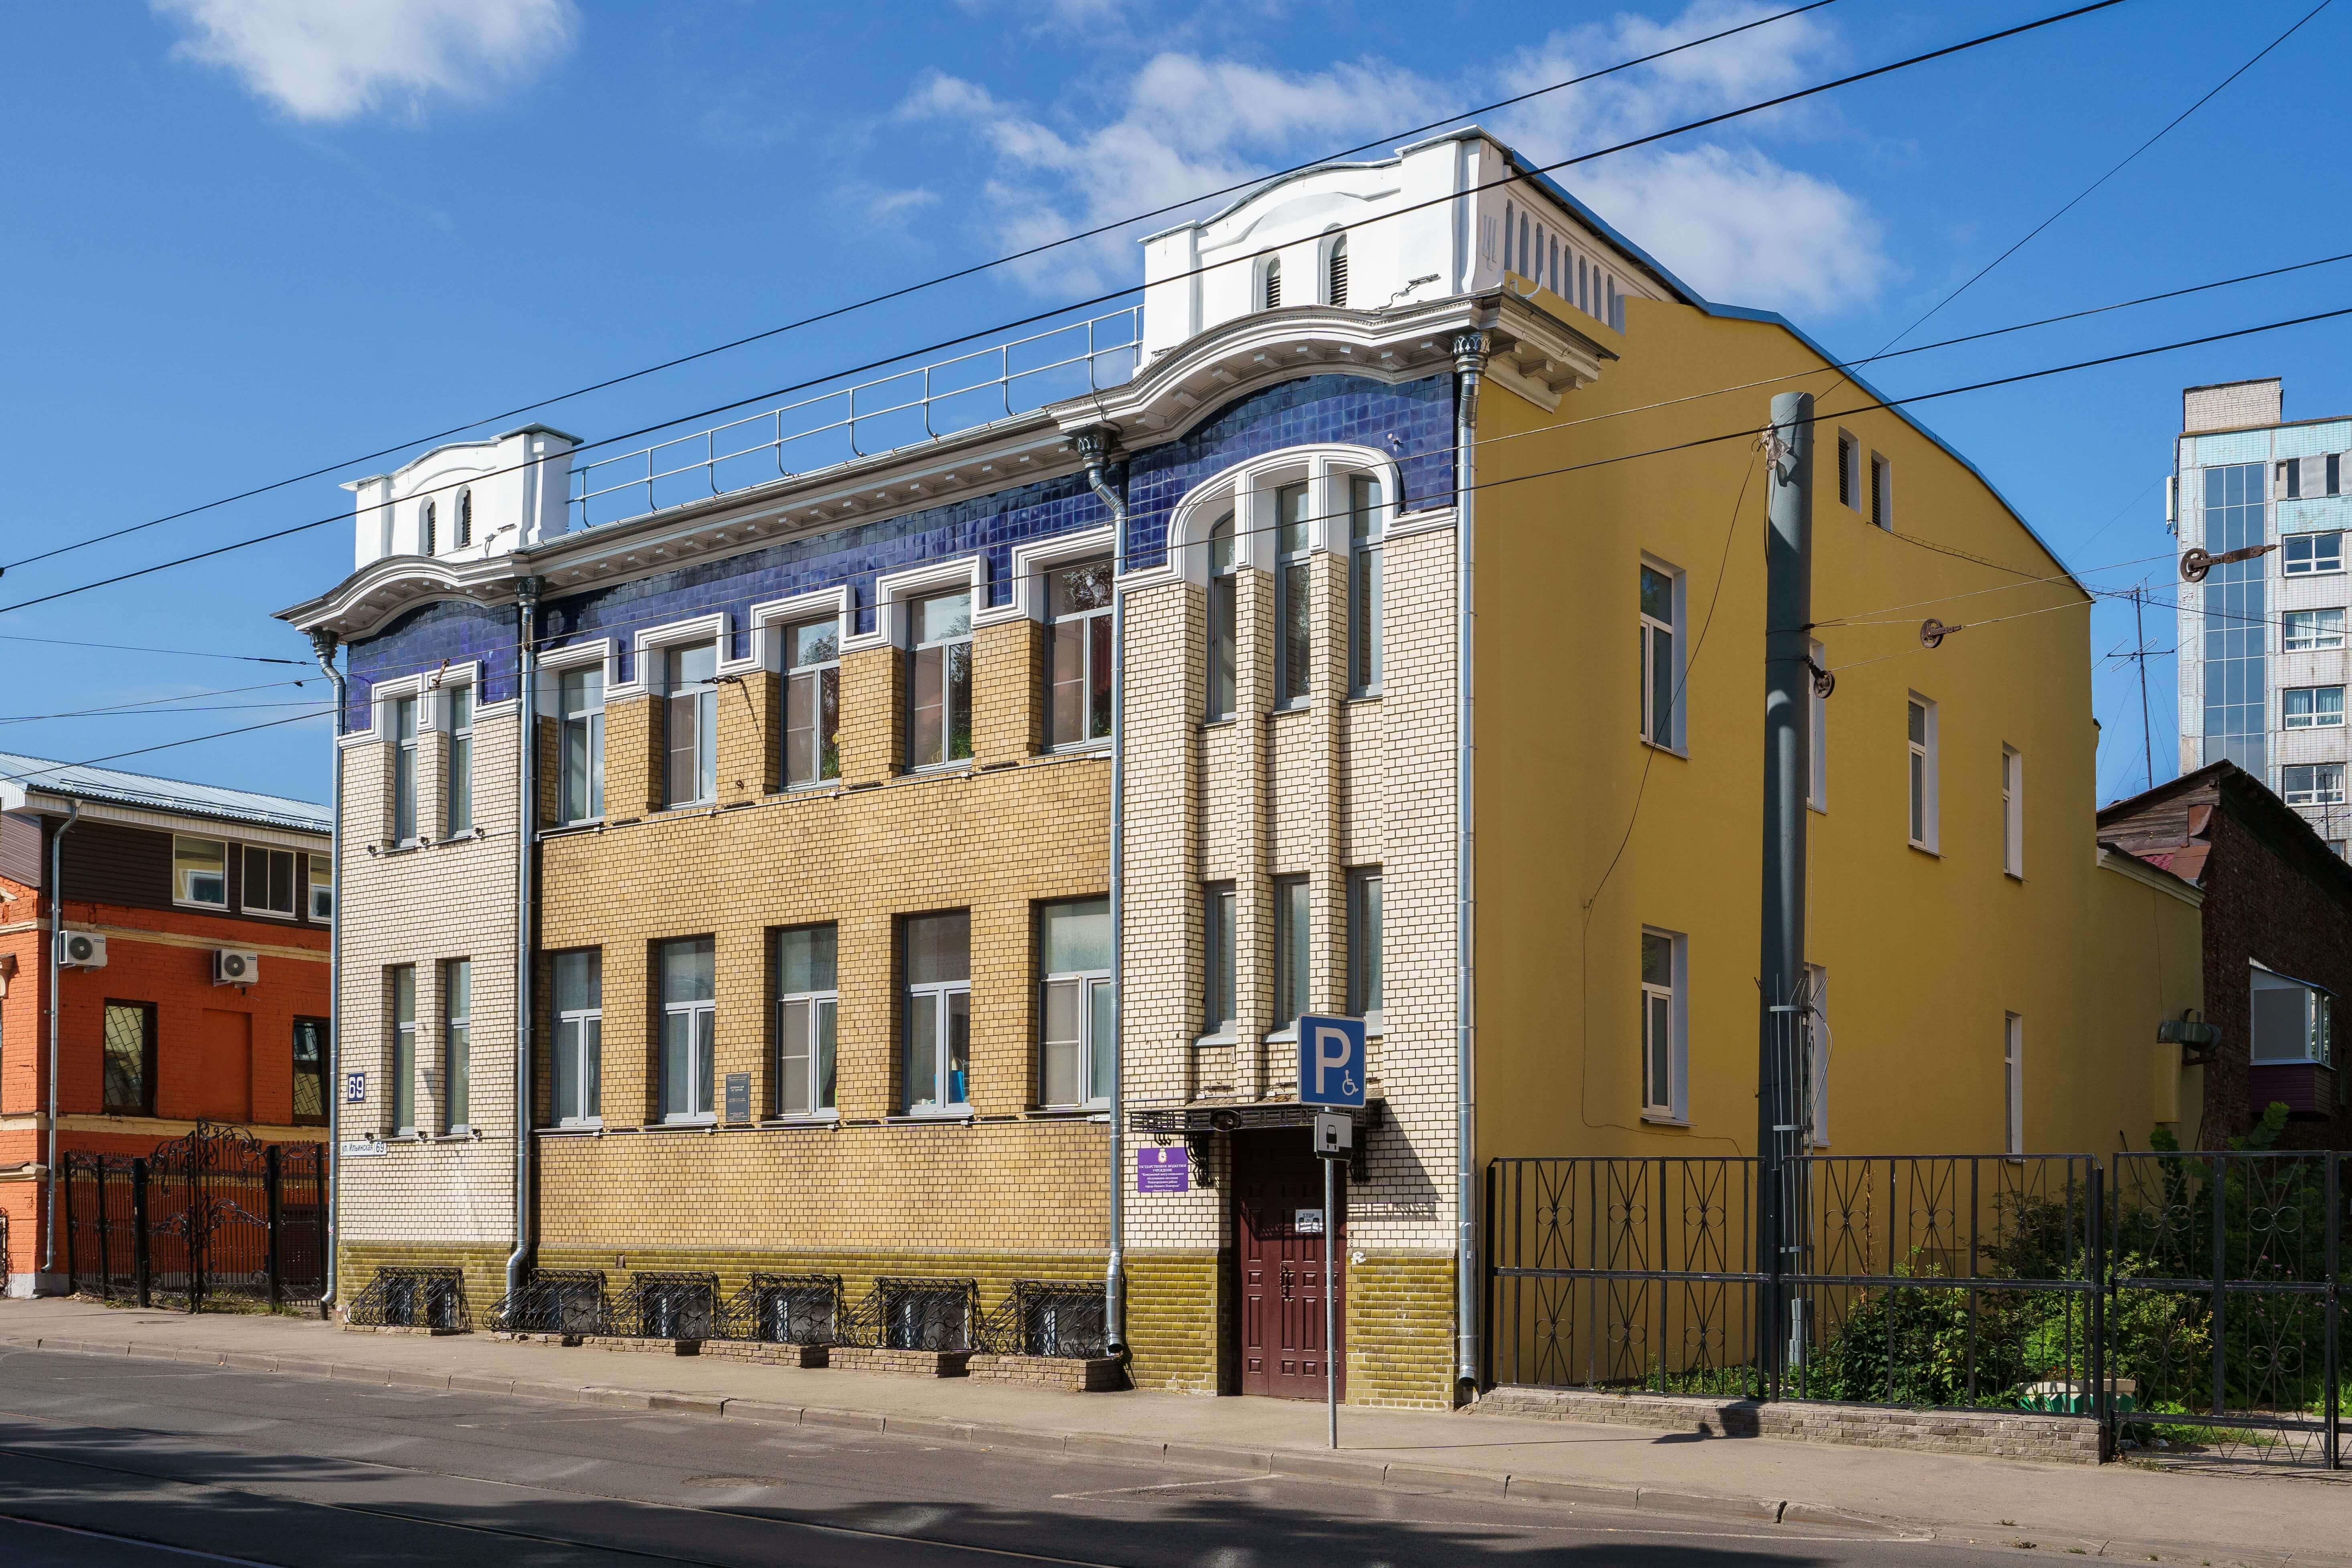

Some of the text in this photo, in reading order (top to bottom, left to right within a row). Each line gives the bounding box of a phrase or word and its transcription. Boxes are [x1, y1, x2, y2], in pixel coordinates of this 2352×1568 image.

[1315, 1026, 1351, 1094] P
[349, 1076, 364, 1098] 69
[349, 1143, 373, 1152] Ильинская
[376, 1141, 384, 1153] 69
